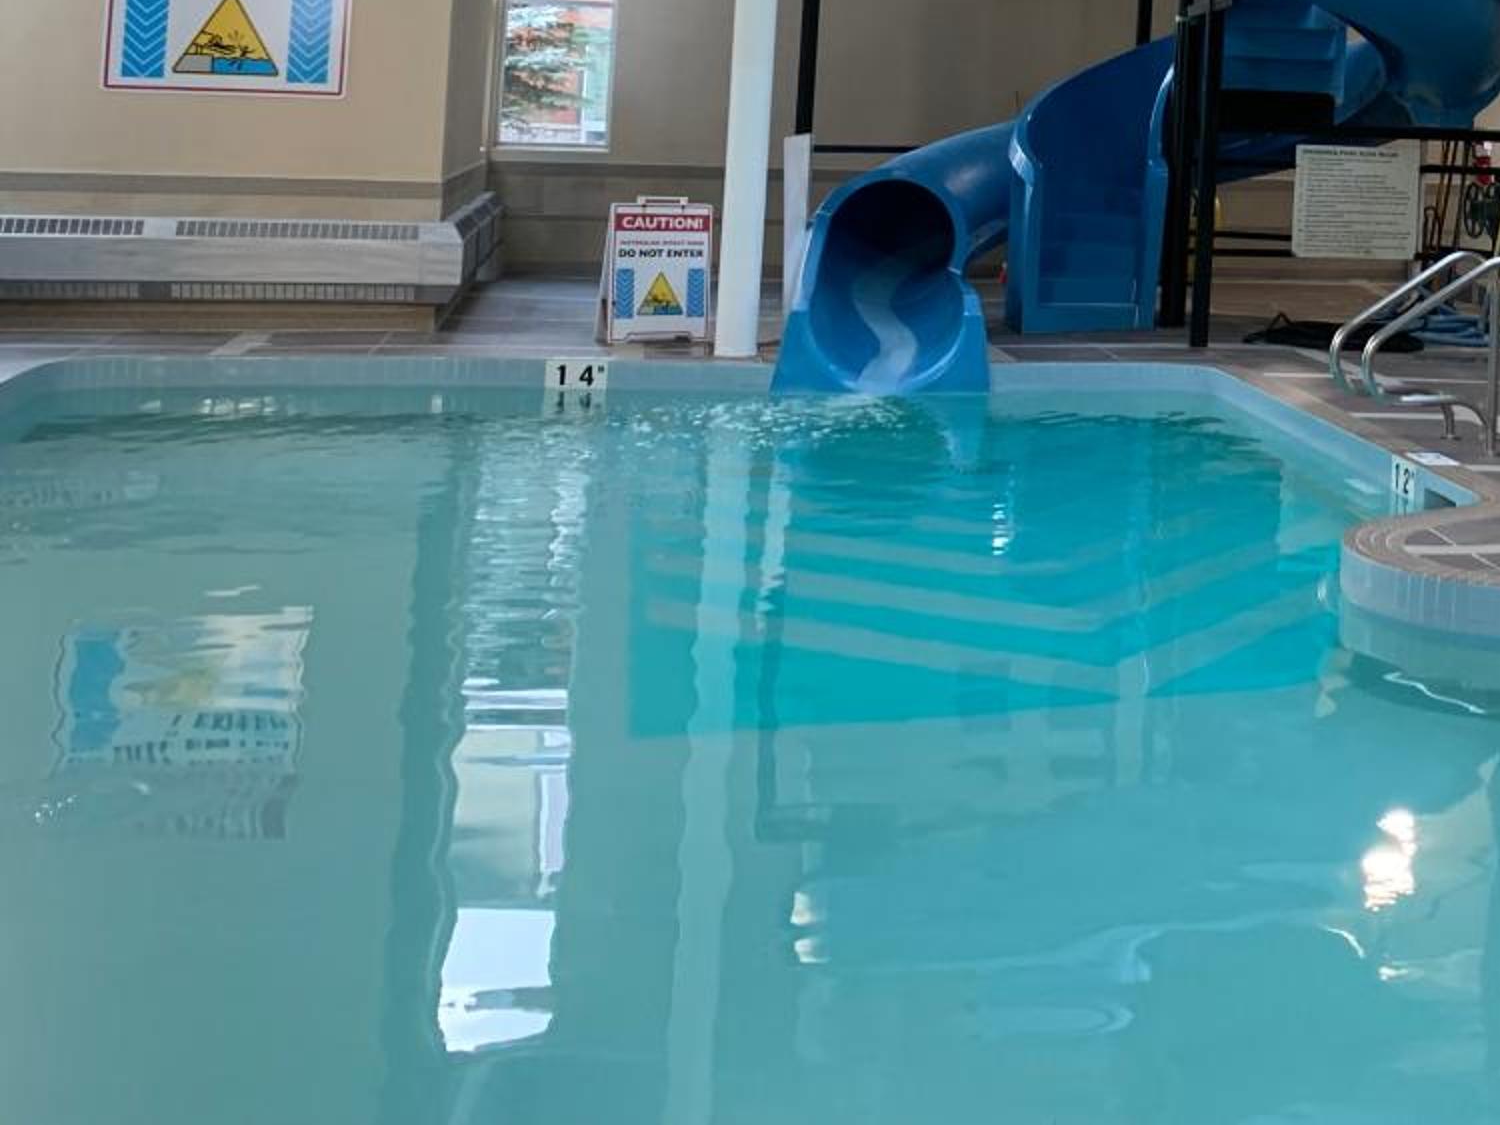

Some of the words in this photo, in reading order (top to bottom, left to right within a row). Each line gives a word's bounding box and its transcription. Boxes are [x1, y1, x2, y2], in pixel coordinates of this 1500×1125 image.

[622, 216, 704, 230] CAUTION!
[618, 248, 636, 258] DO
[639, 248, 664, 258] NOT
[667, 248, 704, 258] ENTER
